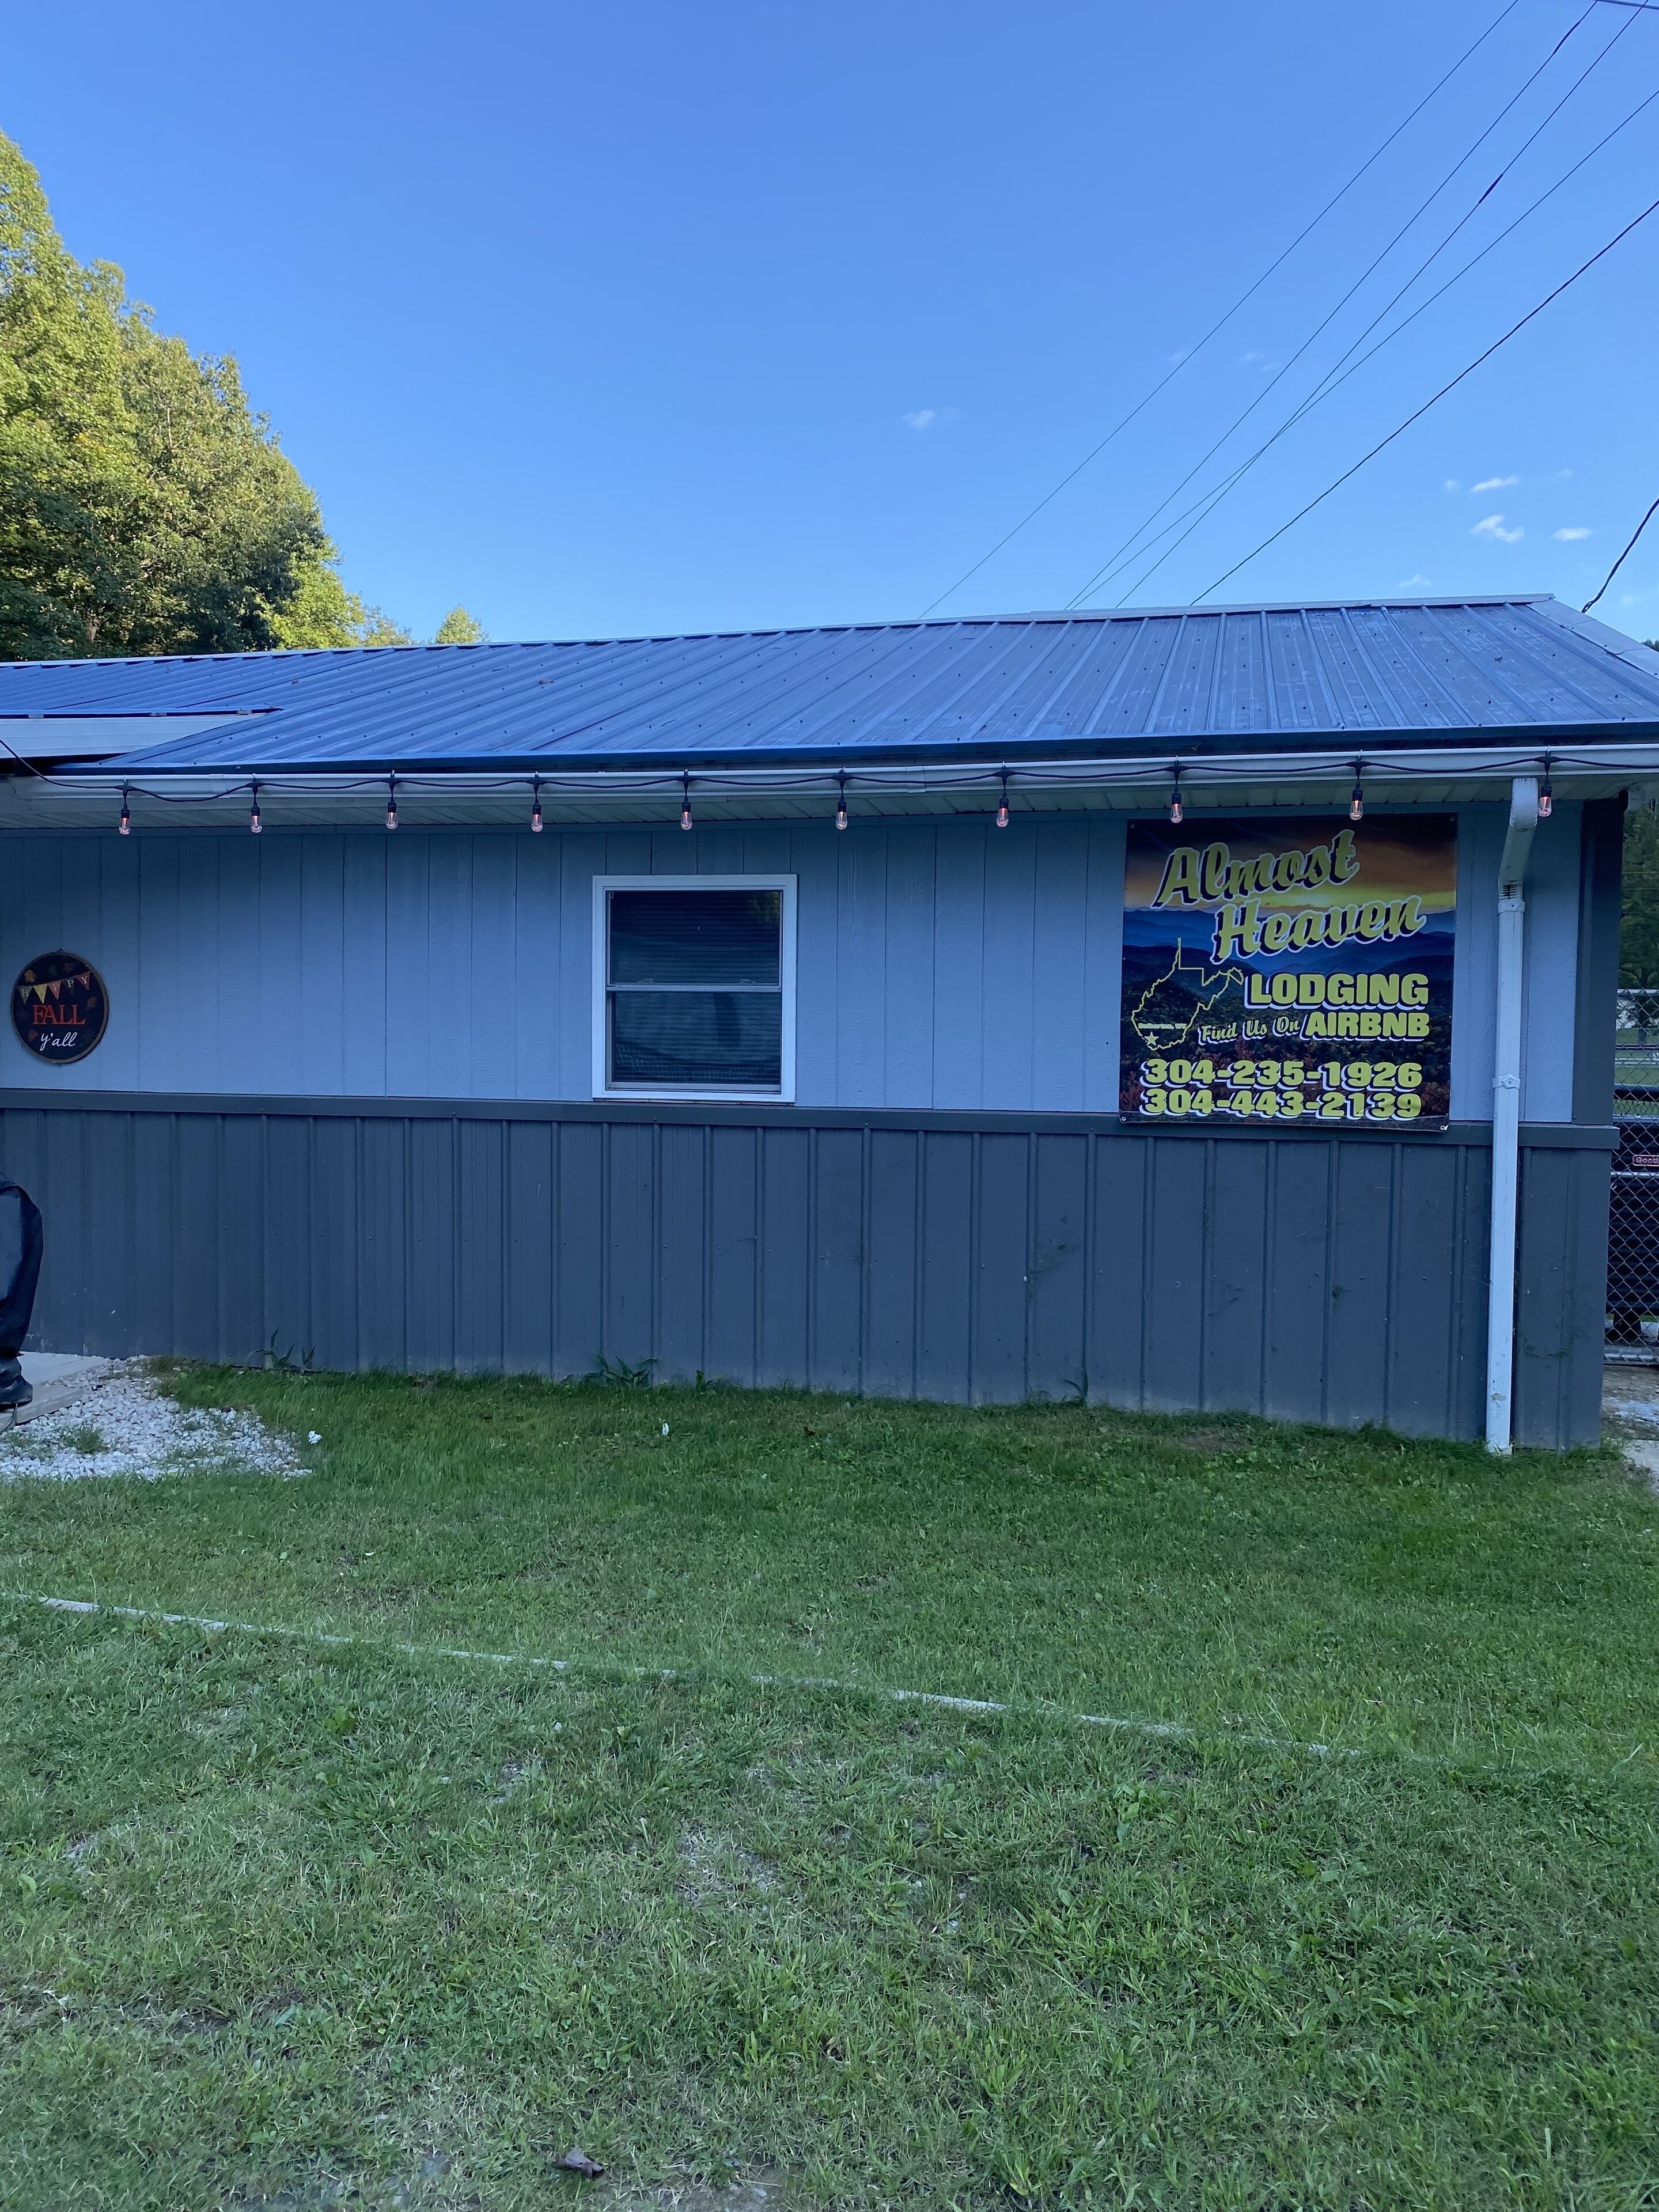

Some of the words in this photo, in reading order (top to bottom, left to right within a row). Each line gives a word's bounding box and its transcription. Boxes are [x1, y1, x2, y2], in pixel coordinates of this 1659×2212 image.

[1153, 830, 1359, 909] Almost
[1211, 895, 1426, 964] Heaven
[21, 975, 88, 997] HPPY
[1246, 974, 1429, 1008] LODGING
[32, 1004, 86, 1025] FALL
[1199, 1022, 1238, 1044] Find
[1244, 1020, 1267, 1039] Us
[1274, 1016, 1301, 1036] On
[1302, 1012, 1430, 1040] AIRBNB
[1141, 1059, 1422, 1090] 304-235-1926
[1141, 1089, 1422, 1120] 304-443-2139
